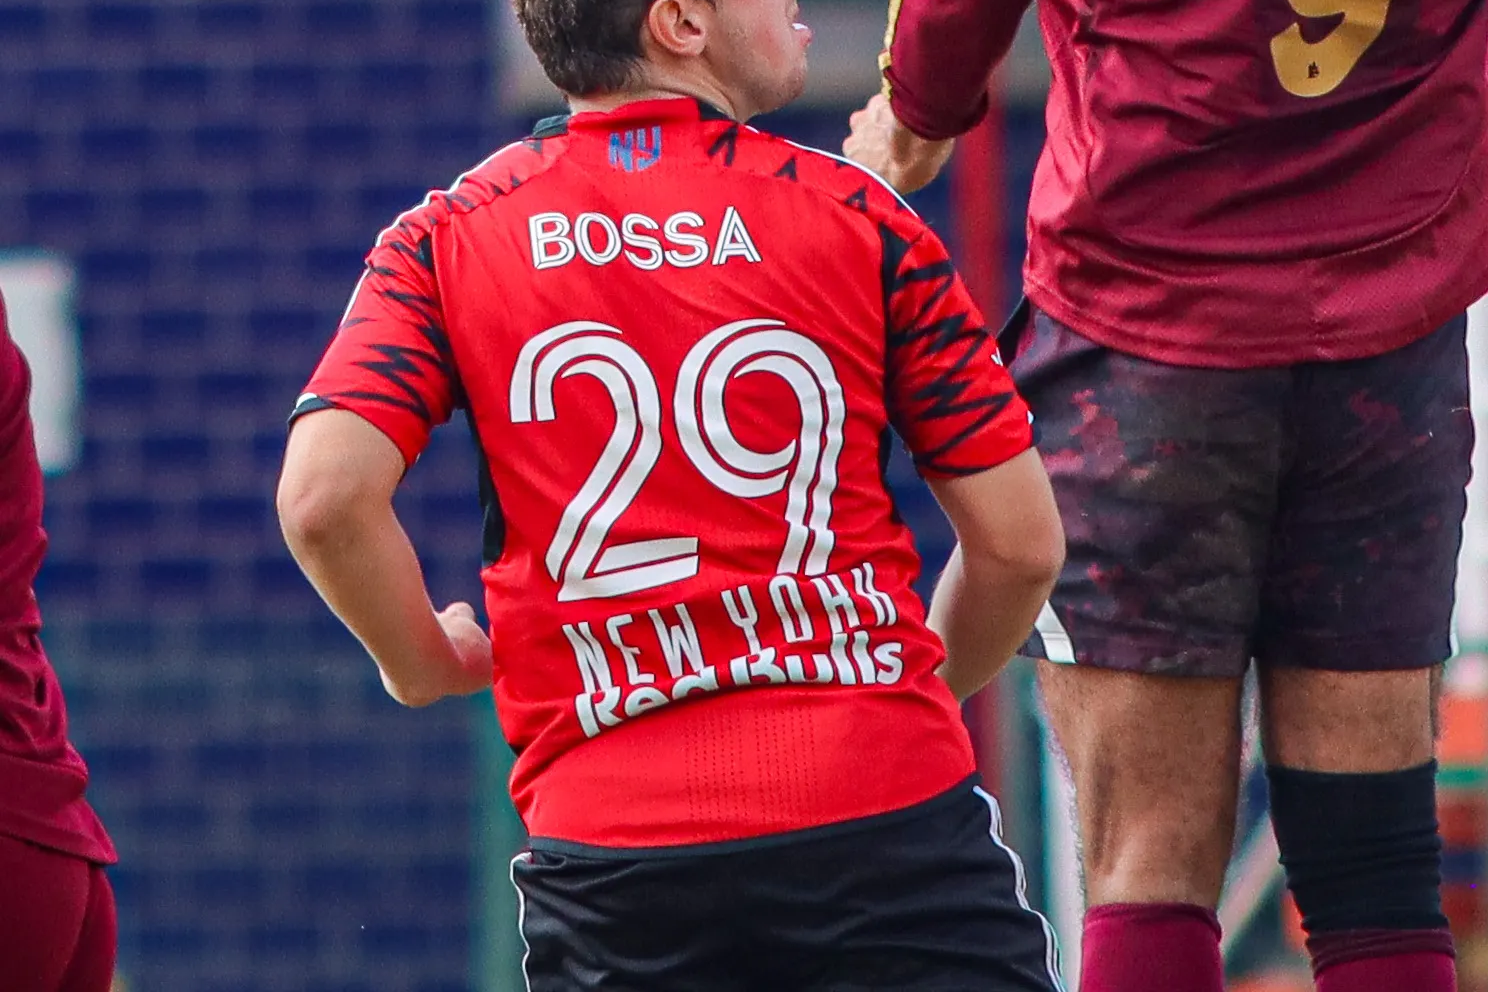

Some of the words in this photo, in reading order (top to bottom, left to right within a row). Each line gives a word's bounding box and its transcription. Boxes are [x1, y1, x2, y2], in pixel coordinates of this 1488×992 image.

[609, 126, 661, 172] NY
[528, 206, 761, 270] BOSSA
[509, 318, 847, 602] 29
[562, 602, 705, 694] NEW
